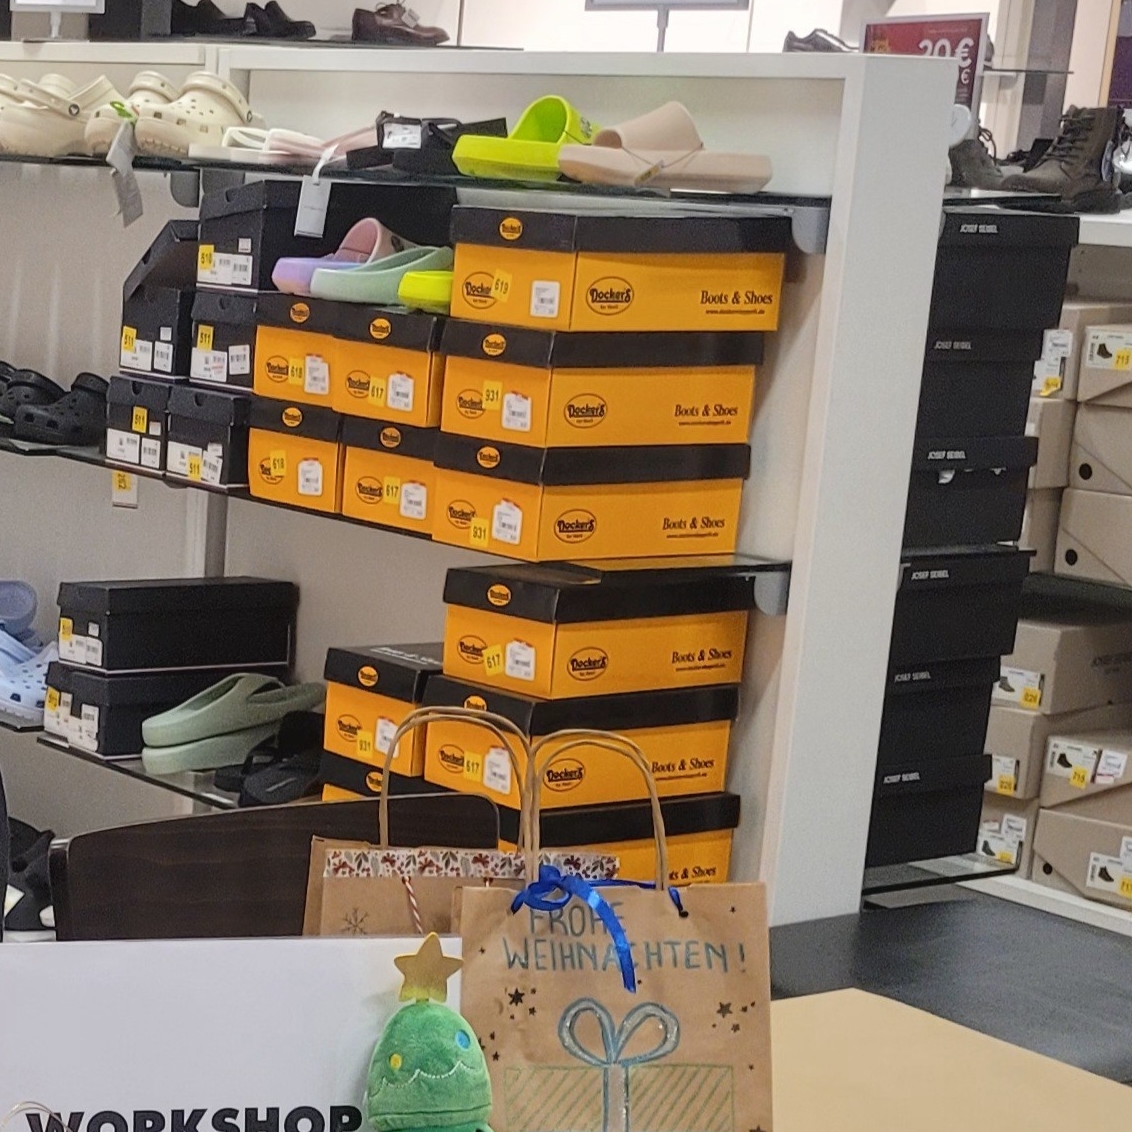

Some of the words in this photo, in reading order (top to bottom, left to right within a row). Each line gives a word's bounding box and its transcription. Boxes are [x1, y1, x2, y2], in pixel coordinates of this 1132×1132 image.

[494, 278, 509, 295] 619
[700, 290, 729, 305] Boots
[732, 291, 741, 305] &
[744, 291, 773, 305] Shoes
[371, 386, 384, 399] 617
[485, 388, 499, 403] 931
[674, 404, 699, 417] Boots
[702, 404, 710, 416] &
[712, 404, 738, 416] Shoes
[385, 484, 399, 498] 617
[662, 517, 687, 531] Boots
[689, 517, 698, 529] &
[700, 516, 726, 529] Shoes
[472, 525, 487, 539] 931
[486, 653, 501, 668] 617
[671, 651, 695, 664] Boots
[698, 649, 705, 662] &
[708, 648, 732, 660] Shoes
[651, 761, 675, 774] Boots
[678, 759, 686, 771] &
[689, 758, 715, 770] Shoes
[692, 866, 716, 878] Shoes
[502, 937, 747, 974] WEIHNAHTEN!
